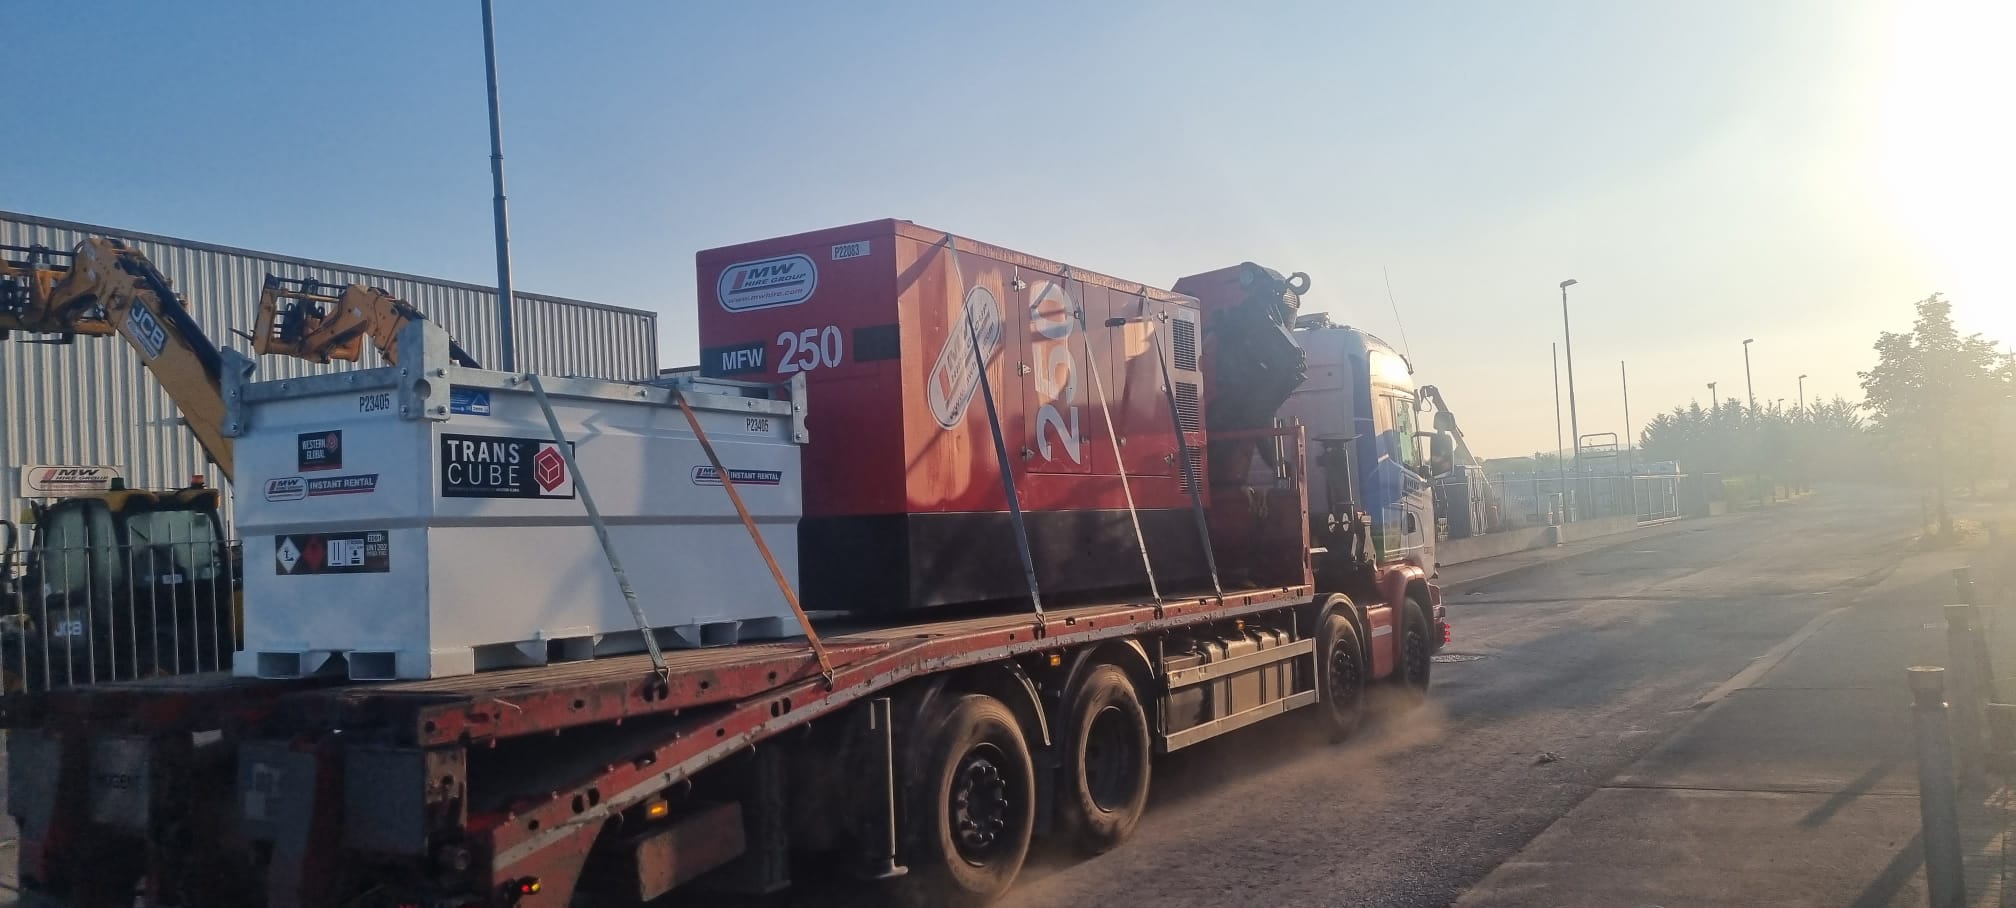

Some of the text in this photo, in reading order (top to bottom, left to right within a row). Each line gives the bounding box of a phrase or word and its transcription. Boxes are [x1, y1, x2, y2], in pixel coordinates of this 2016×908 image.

[748, 262, 795, 279] MW
[744, 273, 806, 288] HIRE GROUP
[131, 307, 165, 350] JCB
[722, 325, 843, 374] MFW 250
[1030, 280, 1081, 465] 250
[359, 393, 390, 412] P23405
[302, 438, 326, 450] WESTERN
[447, 440, 520, 464] TRANS
[306, 449, 326, 460] GLOBAL
[309, 477, 374, 489] INSTANT RENTAL
[447, 463, 520, 486] CUBE
[730, 471, 779, 480] INSTANT RENTAL
